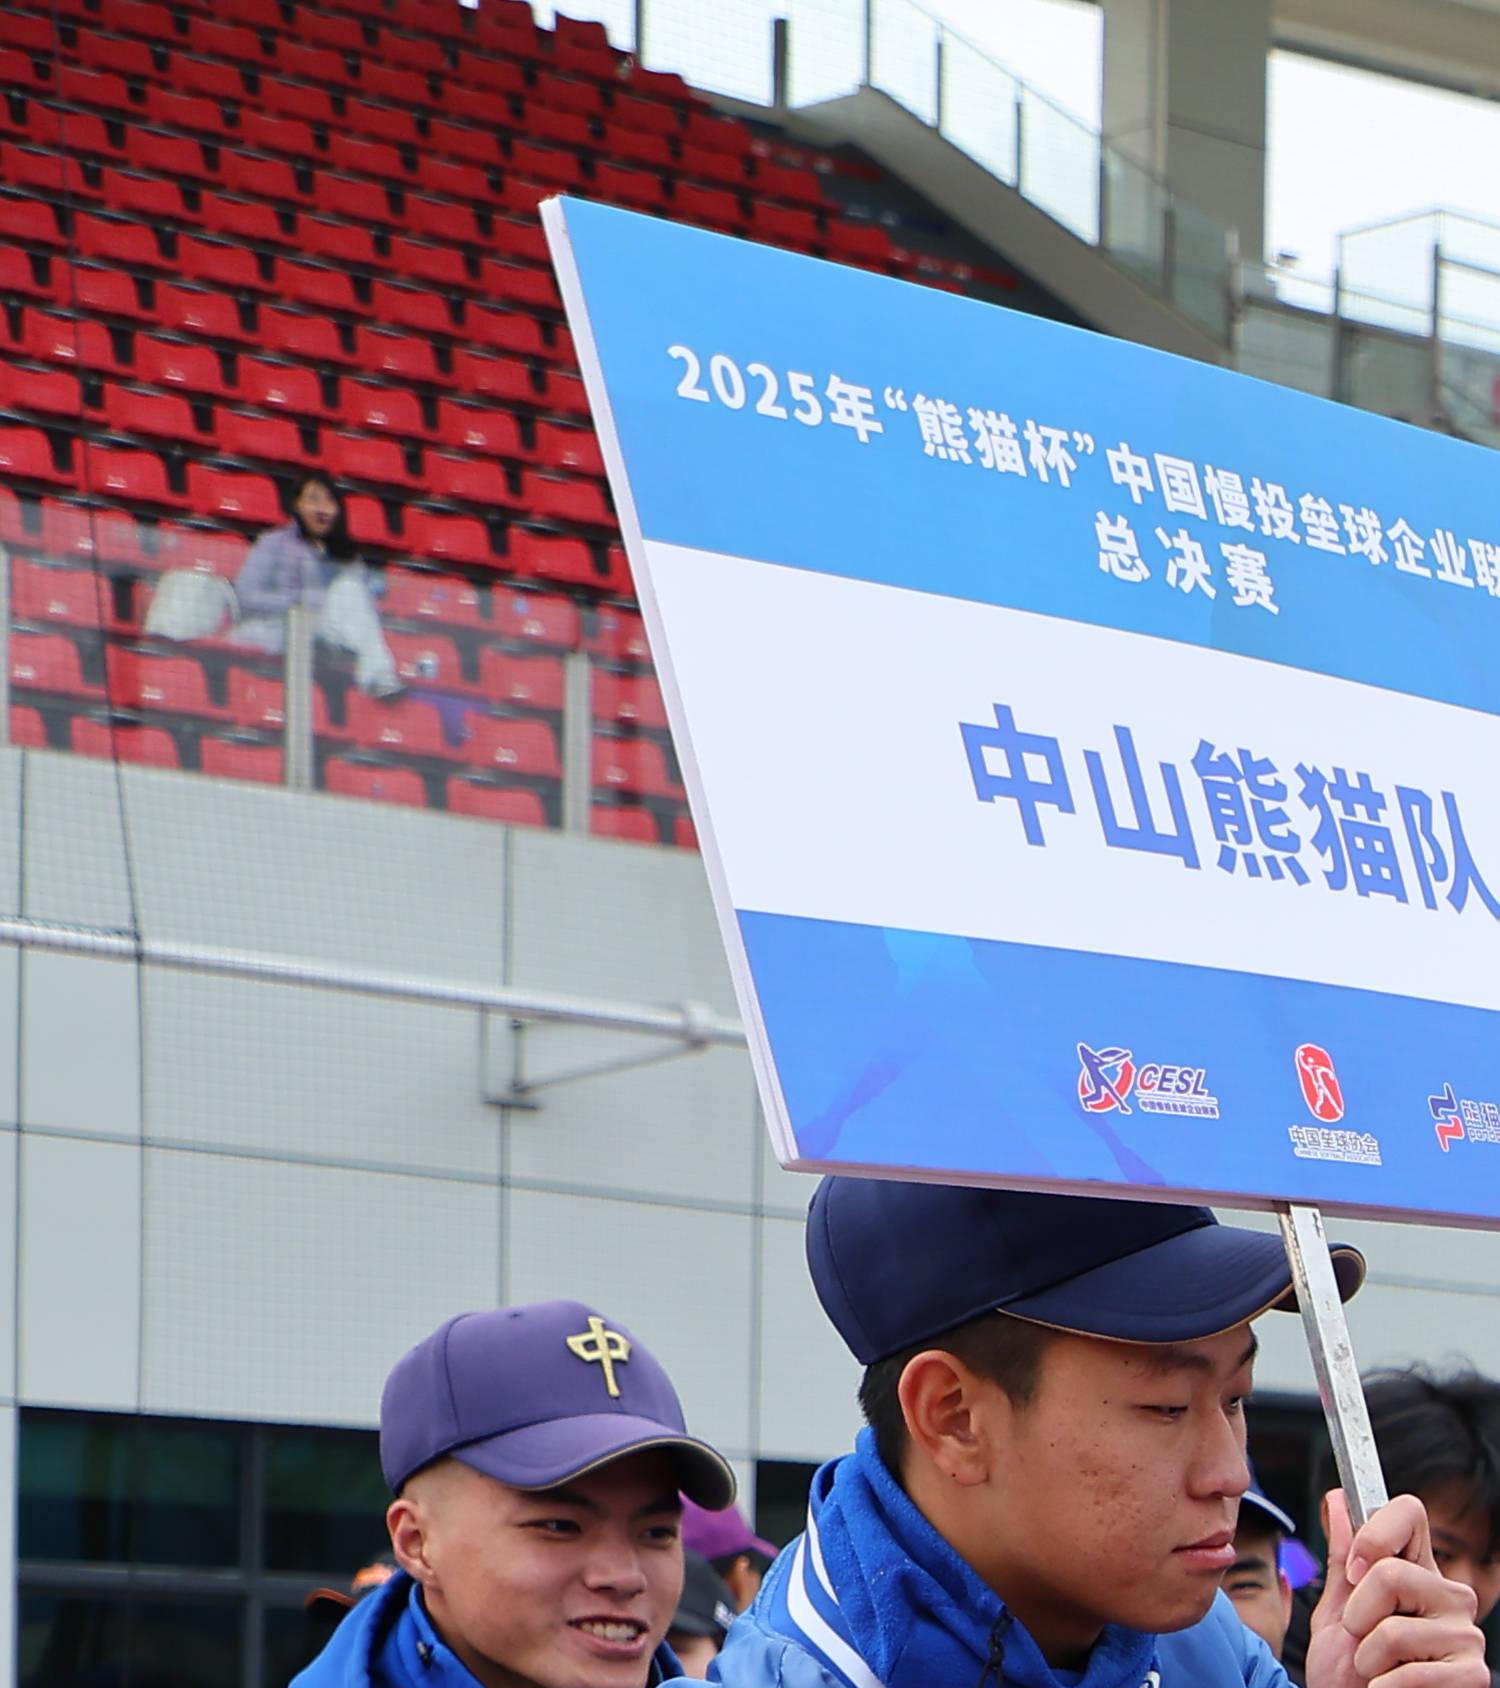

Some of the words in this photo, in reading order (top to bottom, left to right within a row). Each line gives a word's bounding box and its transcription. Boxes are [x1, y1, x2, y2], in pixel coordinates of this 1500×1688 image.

[1094, 510, 1280, 614] 总决赛
[1137, 1064, 1209, 1097] CESL
